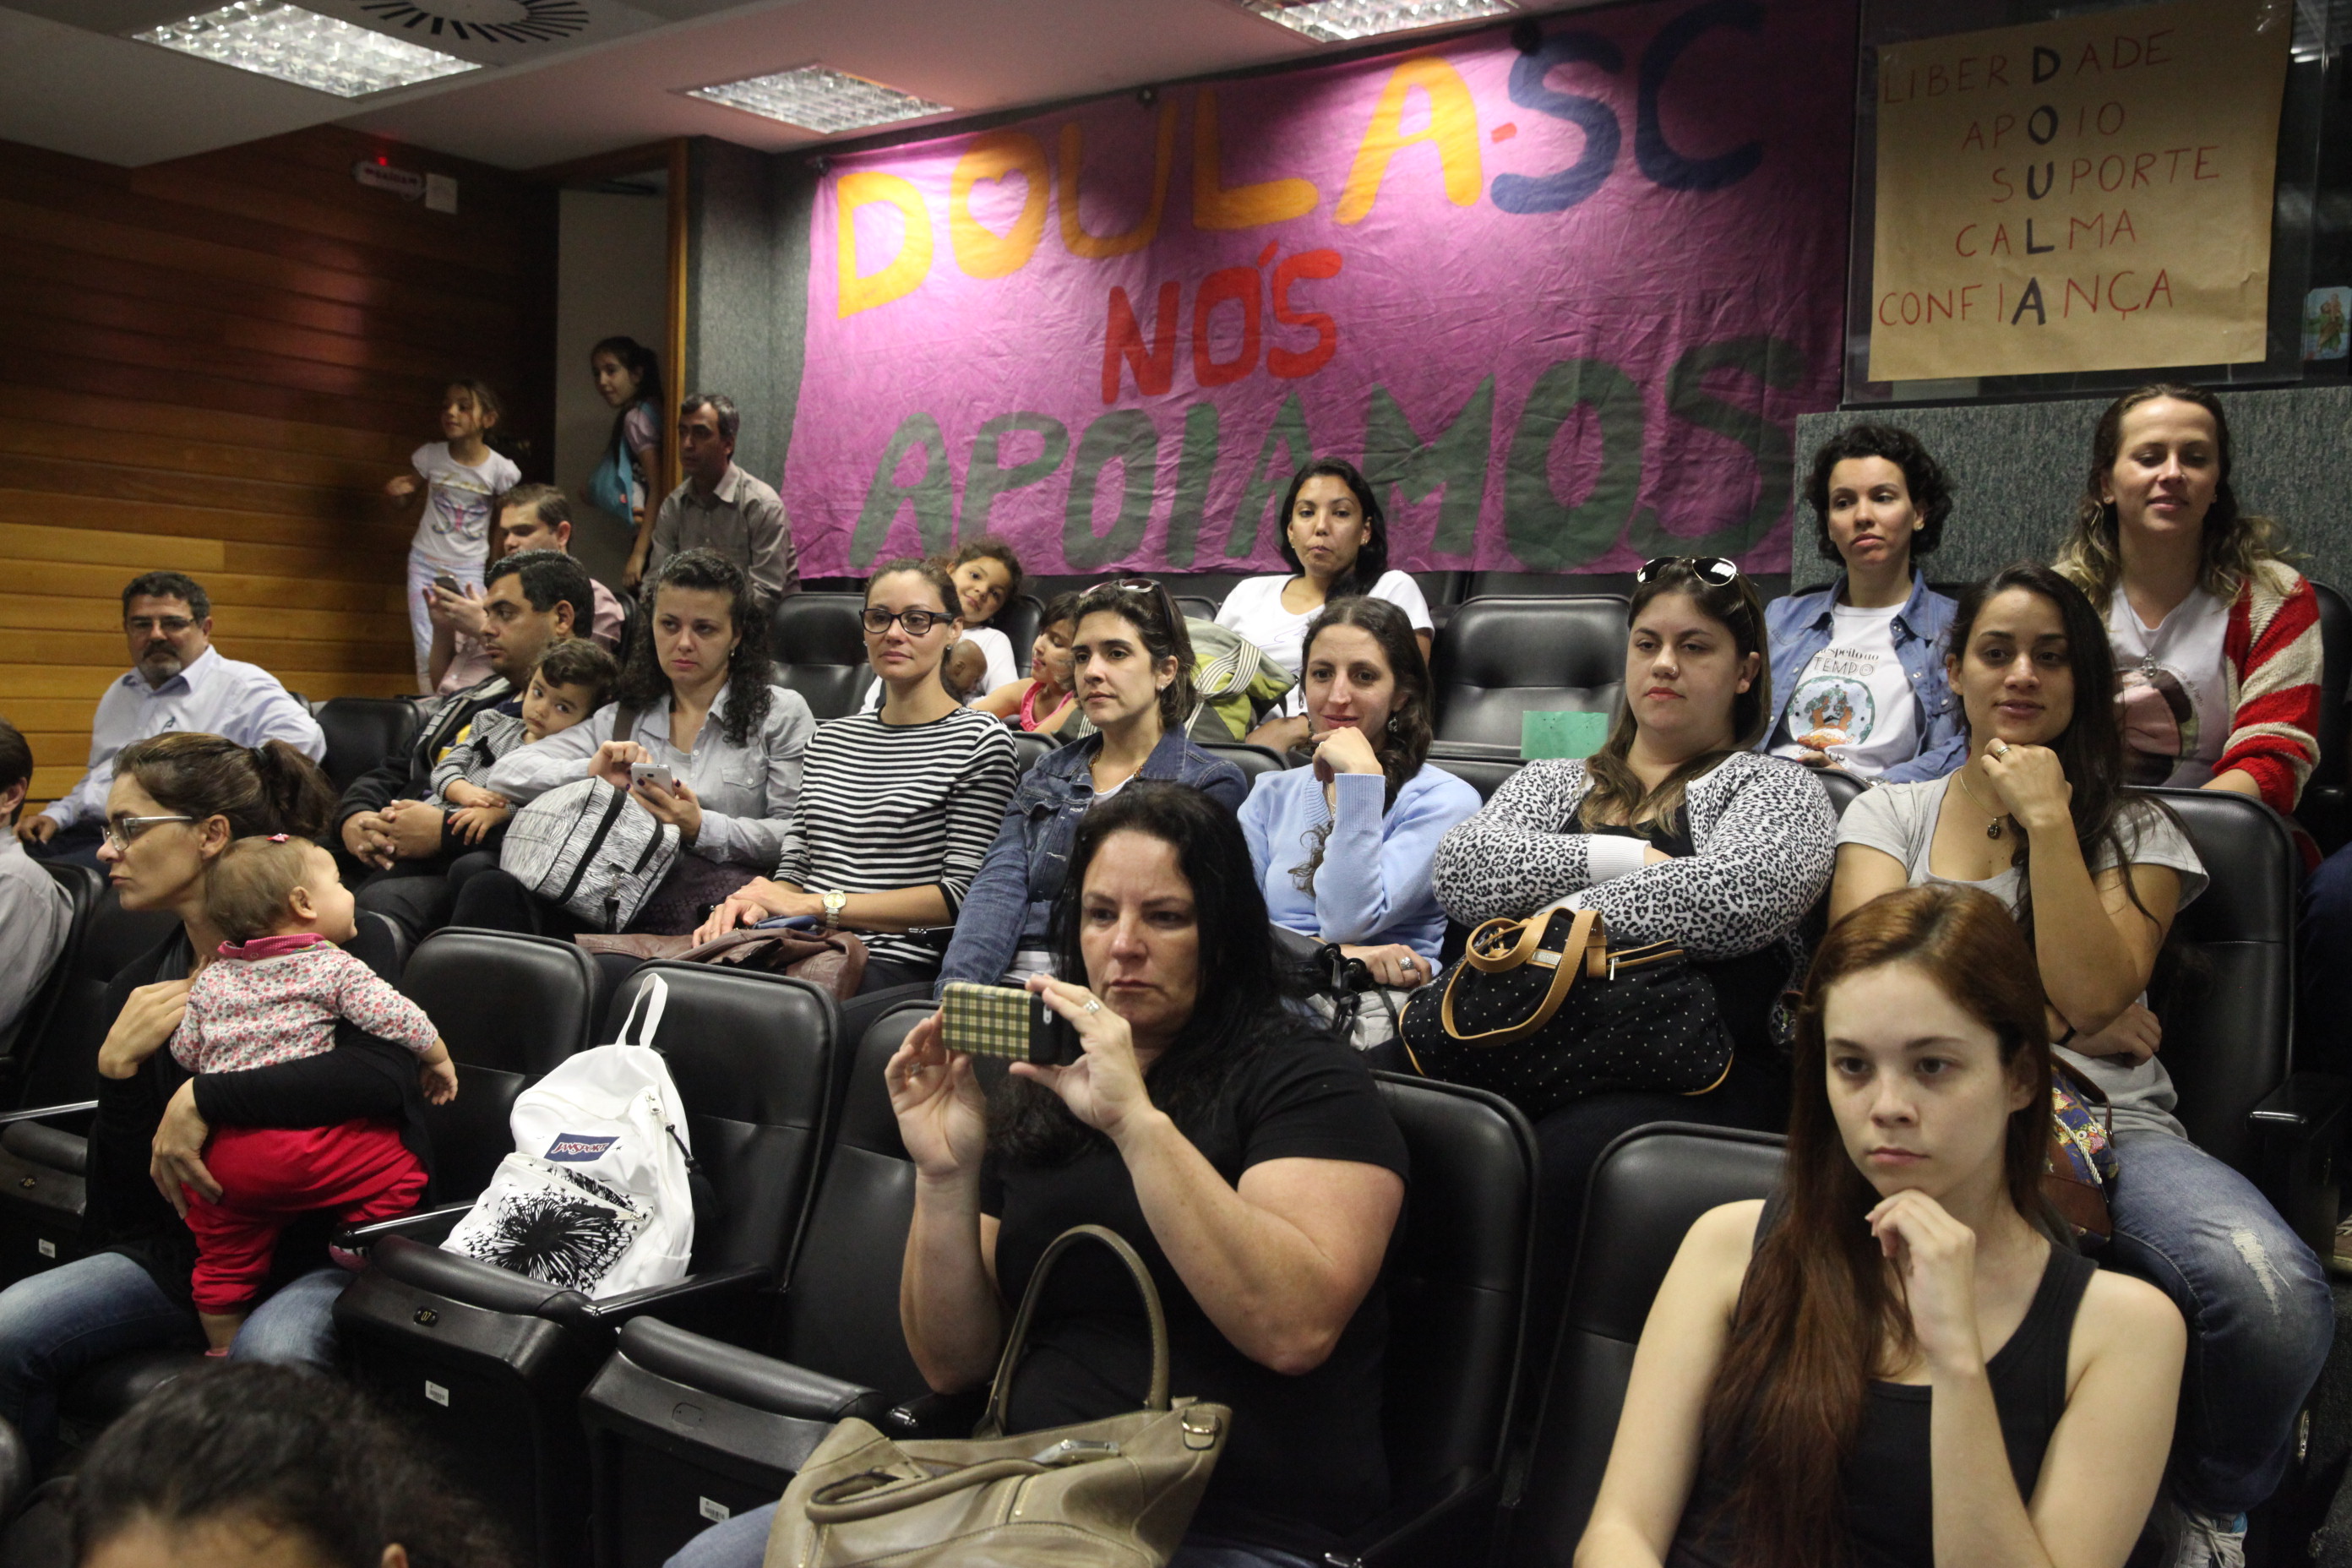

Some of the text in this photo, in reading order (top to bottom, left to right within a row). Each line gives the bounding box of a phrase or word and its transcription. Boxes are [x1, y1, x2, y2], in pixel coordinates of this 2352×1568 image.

[1962, 101, 2125, 150] APOIO
[1991, 146, 2220, 203] SUPORTE
[1956, 210, 2136, 257] CALMA
[1101, 238, 1342, 405] NÓS
[1879, 269, 2174, 326] CONFIANÇA
[849, 335, 1806, 571] APOIAMOS
[1813, 656, 1874, 676] TEMPO
[421, 1311, 432, 1321] 07
